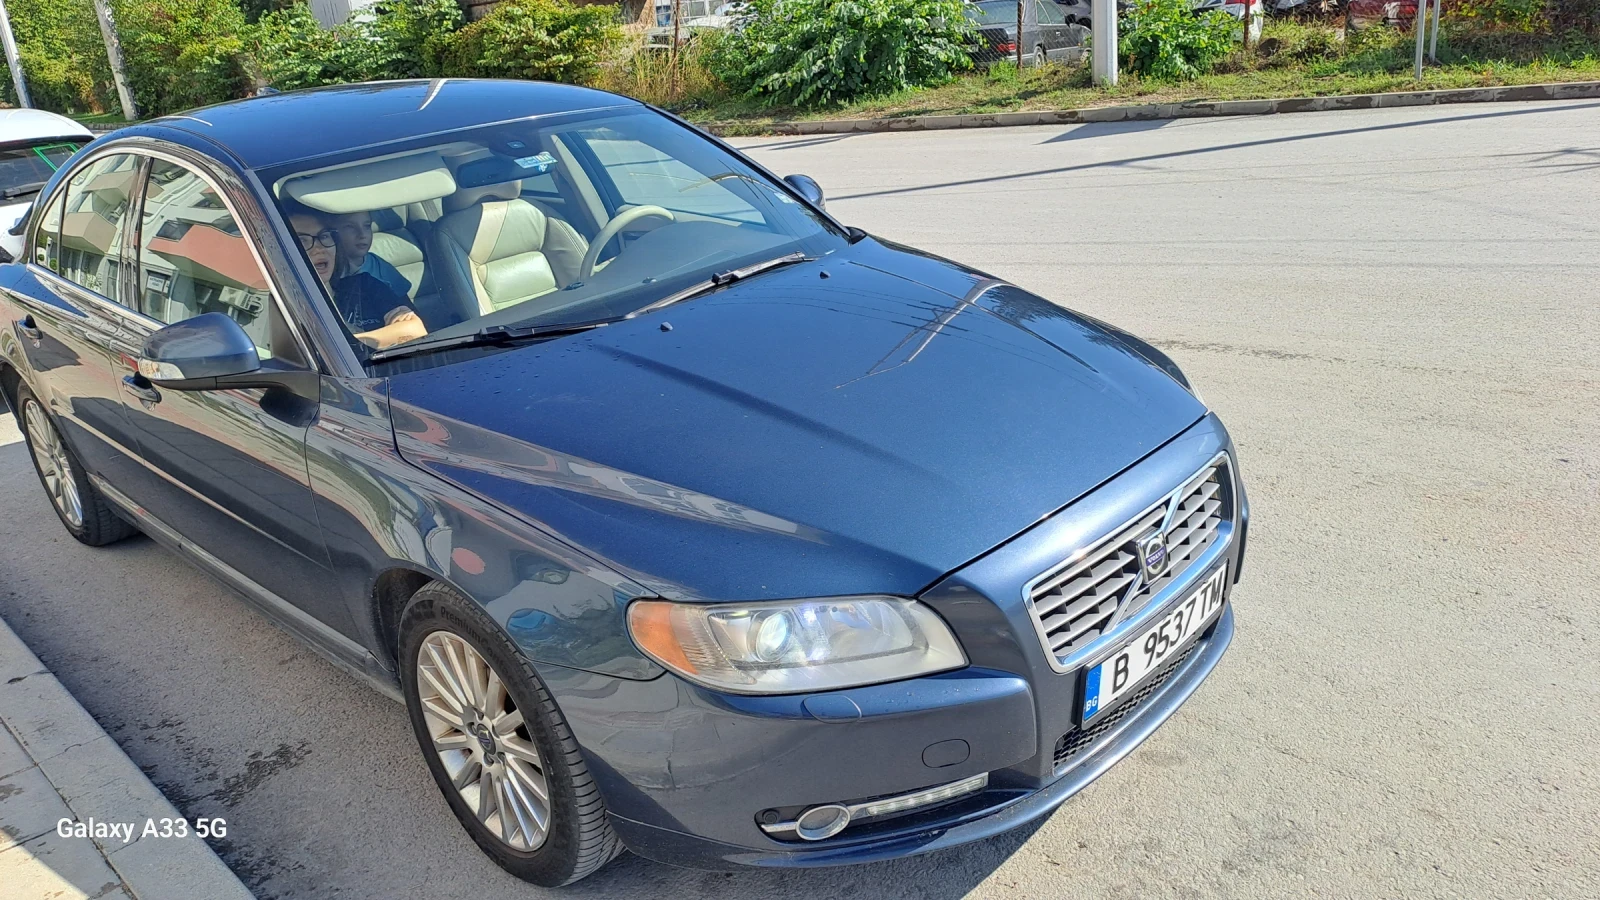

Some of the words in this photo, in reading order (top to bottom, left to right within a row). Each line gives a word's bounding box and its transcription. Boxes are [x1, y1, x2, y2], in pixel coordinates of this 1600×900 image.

[1111, 652, 1130, 695] B
[1143, 597, 1196, 670] 9537
[1200, 570, 1224, 620] TM
[1085, 696, 1098, 712] BG
